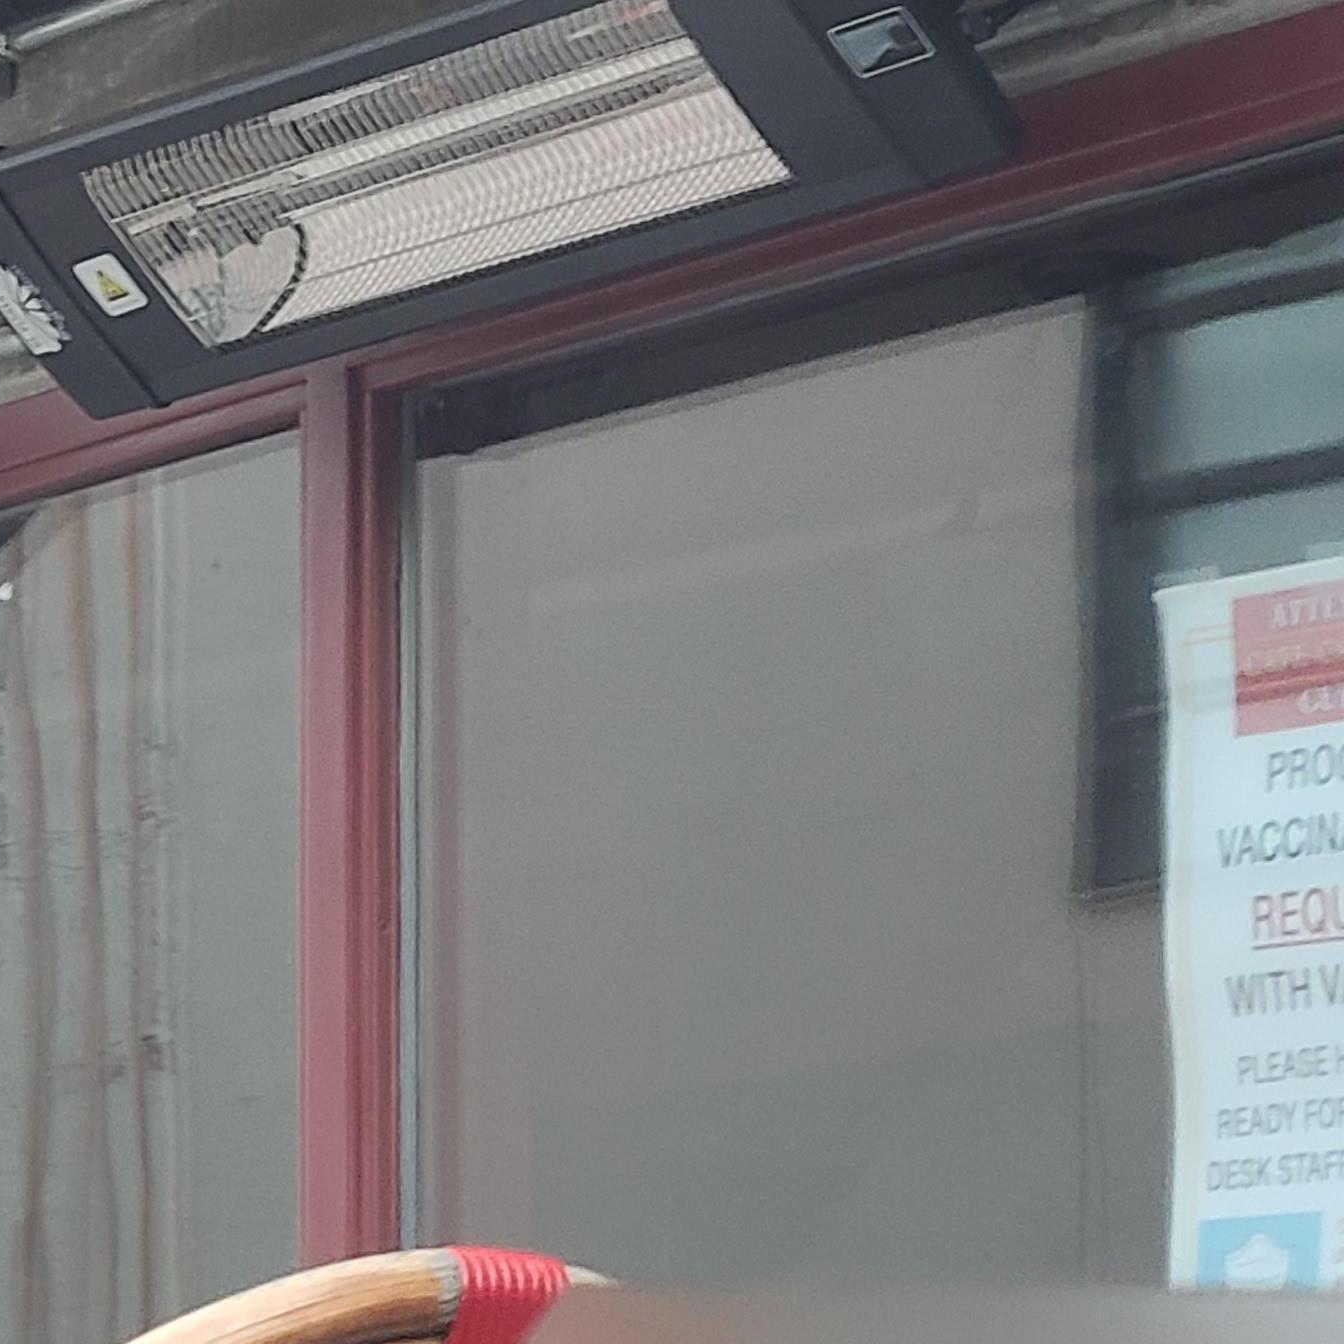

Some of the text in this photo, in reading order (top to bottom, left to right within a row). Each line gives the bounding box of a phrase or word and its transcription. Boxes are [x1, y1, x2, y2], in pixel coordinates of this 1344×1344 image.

[1216, 811, 1344, 868] VACCIN
[1224, 967, 1312, 1017] WITH
[1237, 1044, 1329, 1086] PLEASE
[1216, 1100, 1298, 1139] READY
[1207, 1156, 1272, 1193] DESK
